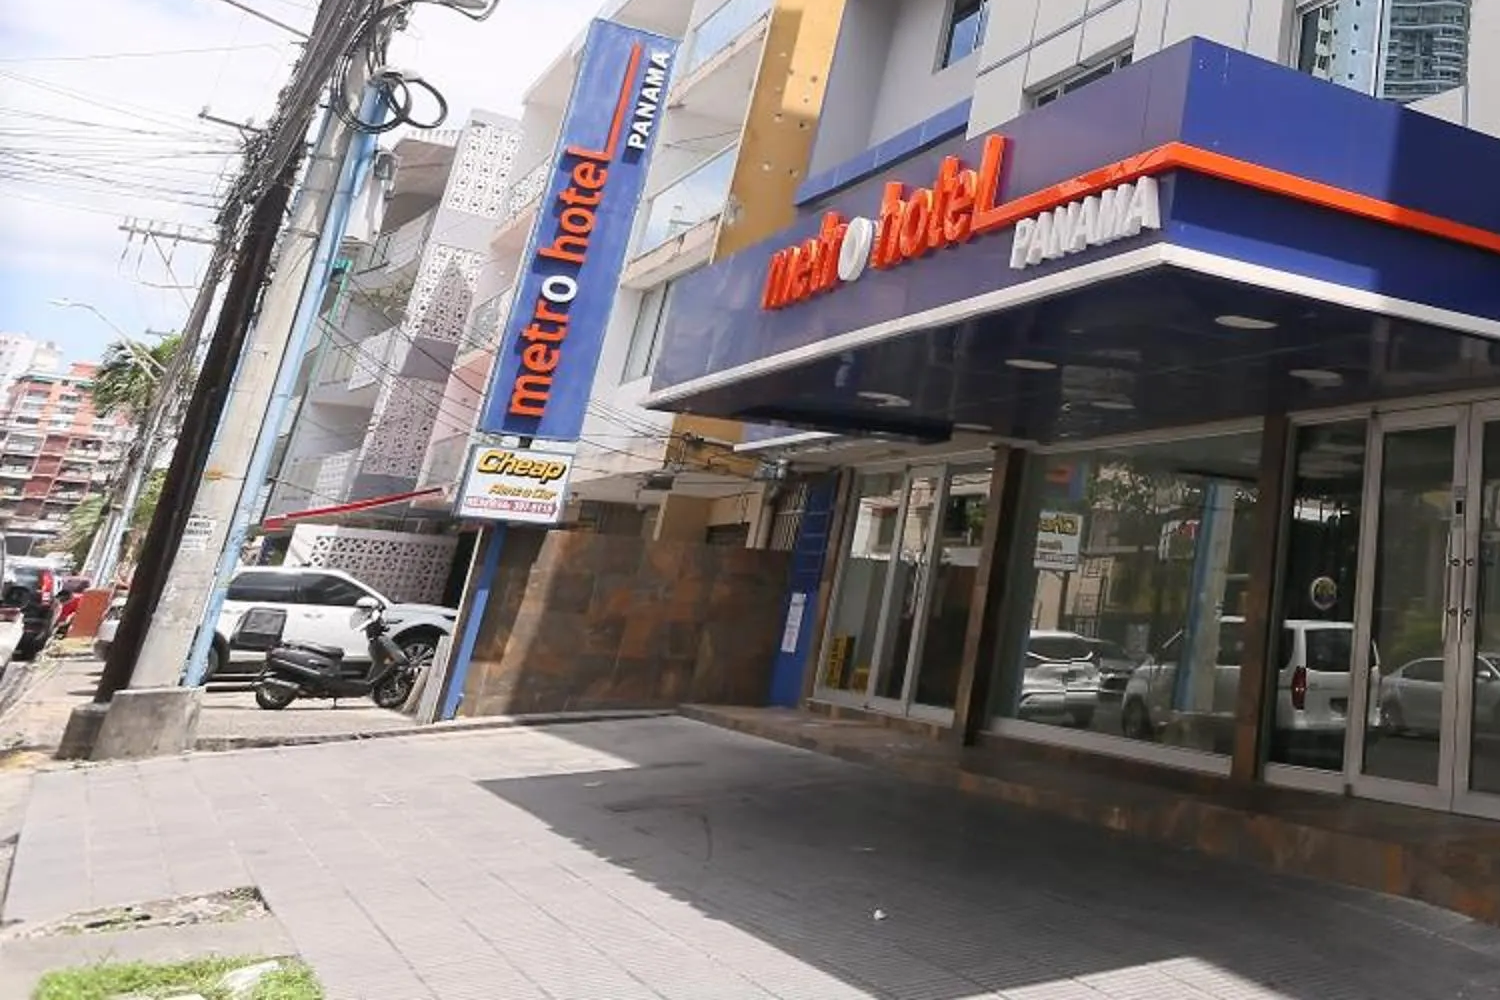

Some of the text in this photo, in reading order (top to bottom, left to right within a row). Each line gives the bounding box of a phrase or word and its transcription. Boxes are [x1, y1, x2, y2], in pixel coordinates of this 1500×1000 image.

[627, 51, 671, 149] PANAMA
[870, 134, 1009, 270] hotel
[1010, 176, 1161, 270] PANAMA
[508, 146, 615, 417] metro hotel
[478, 449, 566, 485] Cheap
